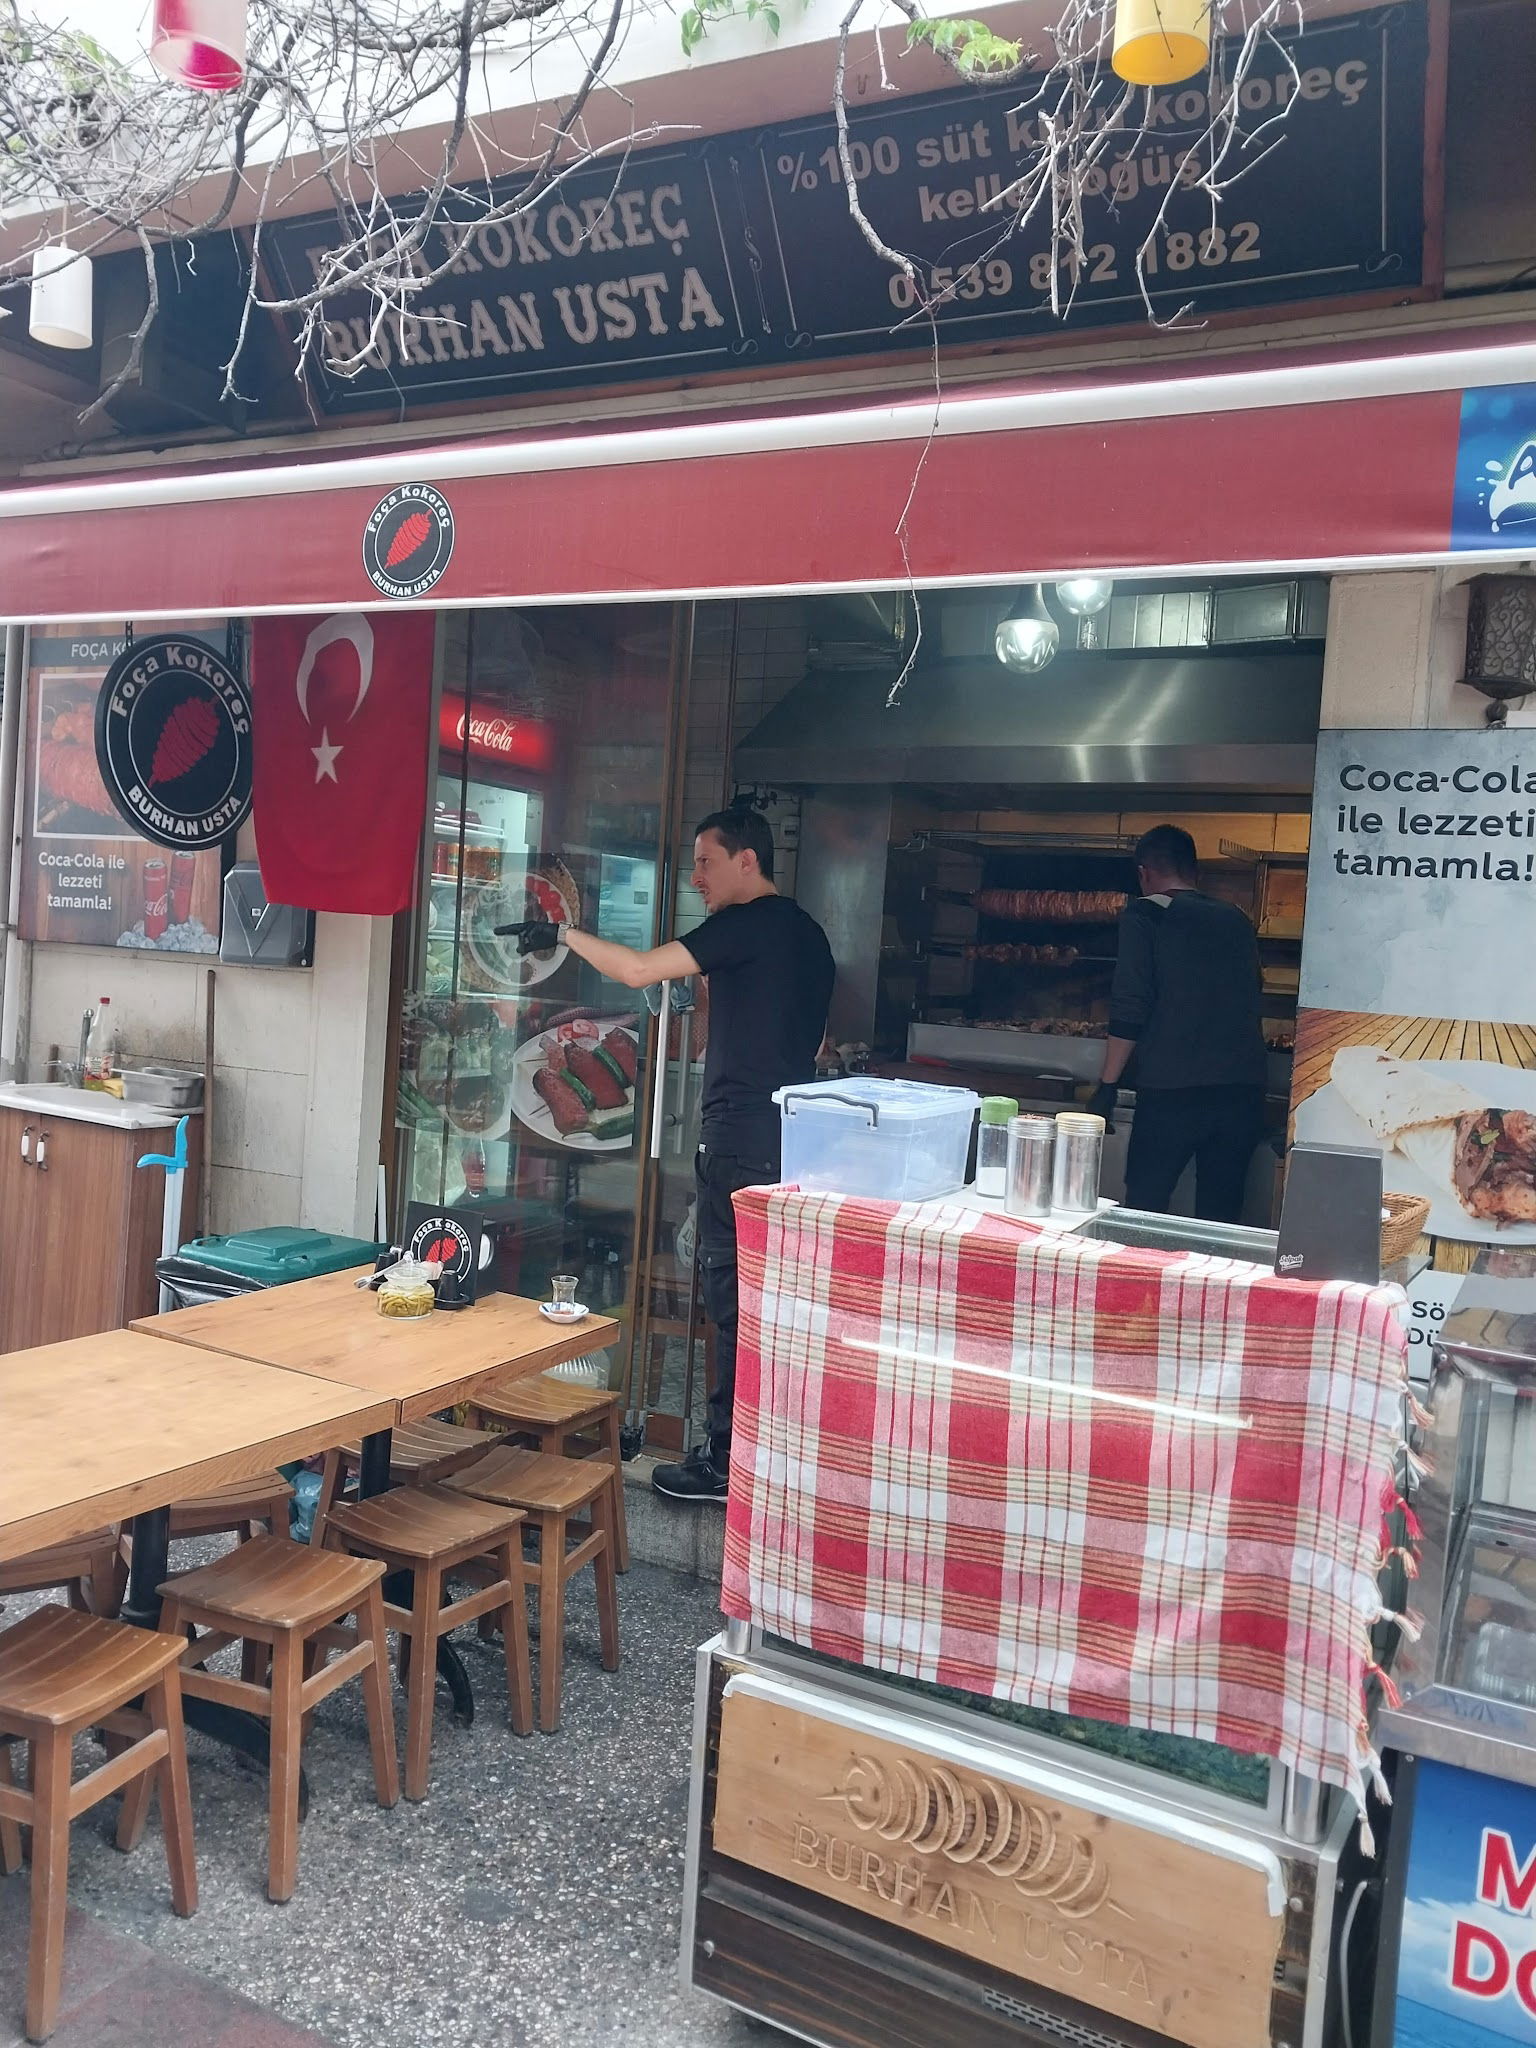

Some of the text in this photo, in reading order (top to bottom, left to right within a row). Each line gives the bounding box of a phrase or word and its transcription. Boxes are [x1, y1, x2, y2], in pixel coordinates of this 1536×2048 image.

[777, 135, 900, 192] %100
[916, 120, 992, 168] süt
[918, 173, 1035, 223] kelle
[440, 183, 690, 275] KOKOREÇ
[930, 258, 1012, 303] 539
[1029, 243, 1118, 290] 812
[1136, 222, 1261, 275] 1882
[325, 266, 724, 370] BURHAN USTA
[367, 486, 450, 533] Foça Kokoreç
[372, 569, 441, 596] BURHAN USTA
[71, 642, 109, 660] FOÇA
[111, 646, 249, 735] Foça Kokoreç
[128, 785, 242, 836] BURHAN USTA
[1337, 804, 1536, 838] ile lezzeti
[38, 851, 125, 870] Coca-Cola ile
[58, 873, 103, 889] lezzeti
[1333, 847, 1535, 882] tamamla!
[47, 893, 112, 911] tamamla!
[789, 1821, 1155, 2007] BURHAN USTA
